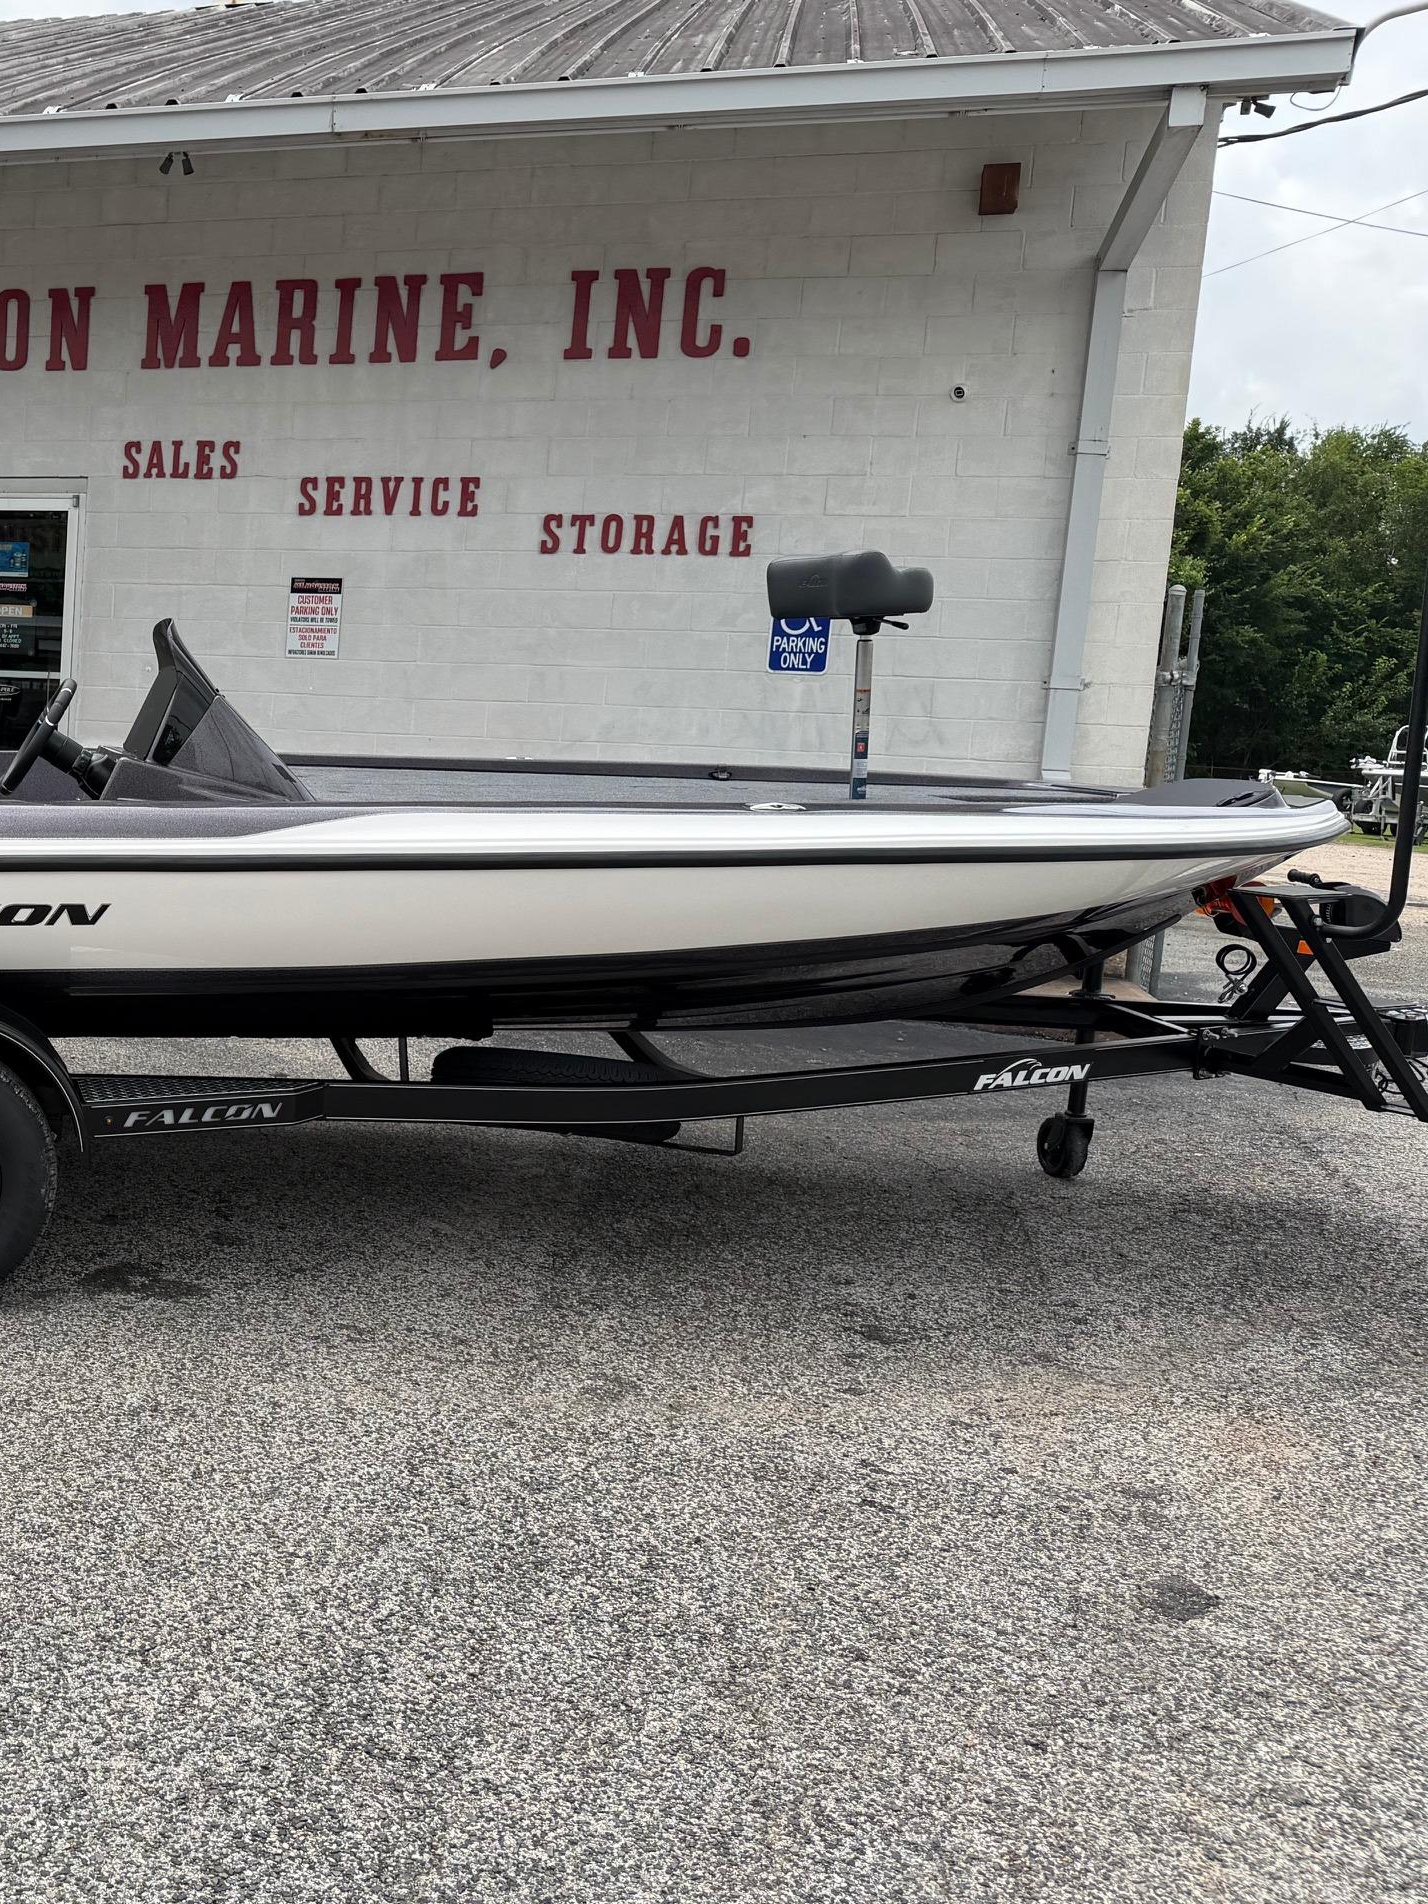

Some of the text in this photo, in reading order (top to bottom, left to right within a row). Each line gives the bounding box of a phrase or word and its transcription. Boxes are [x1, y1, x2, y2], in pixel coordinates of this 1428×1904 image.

[141, 272, 507, 370] MARINE,
[564, 267, 751, 360] INC.
[123, 440, 242, 480] SALES
[298, 477, 482, 517] SERVICE
[540, 514, 755, 557] STORAGE
[290, 605, 339, 616] PARKING ONLY
[297, 595, 333, 605] CUSTOMER
[772, 636, 826, 653] PARKING
[780, 653, 815, 669] ONLY
[973, 1063, 1091, 1091] FALCON
[123, 1102, 283, 1128] FALCON
